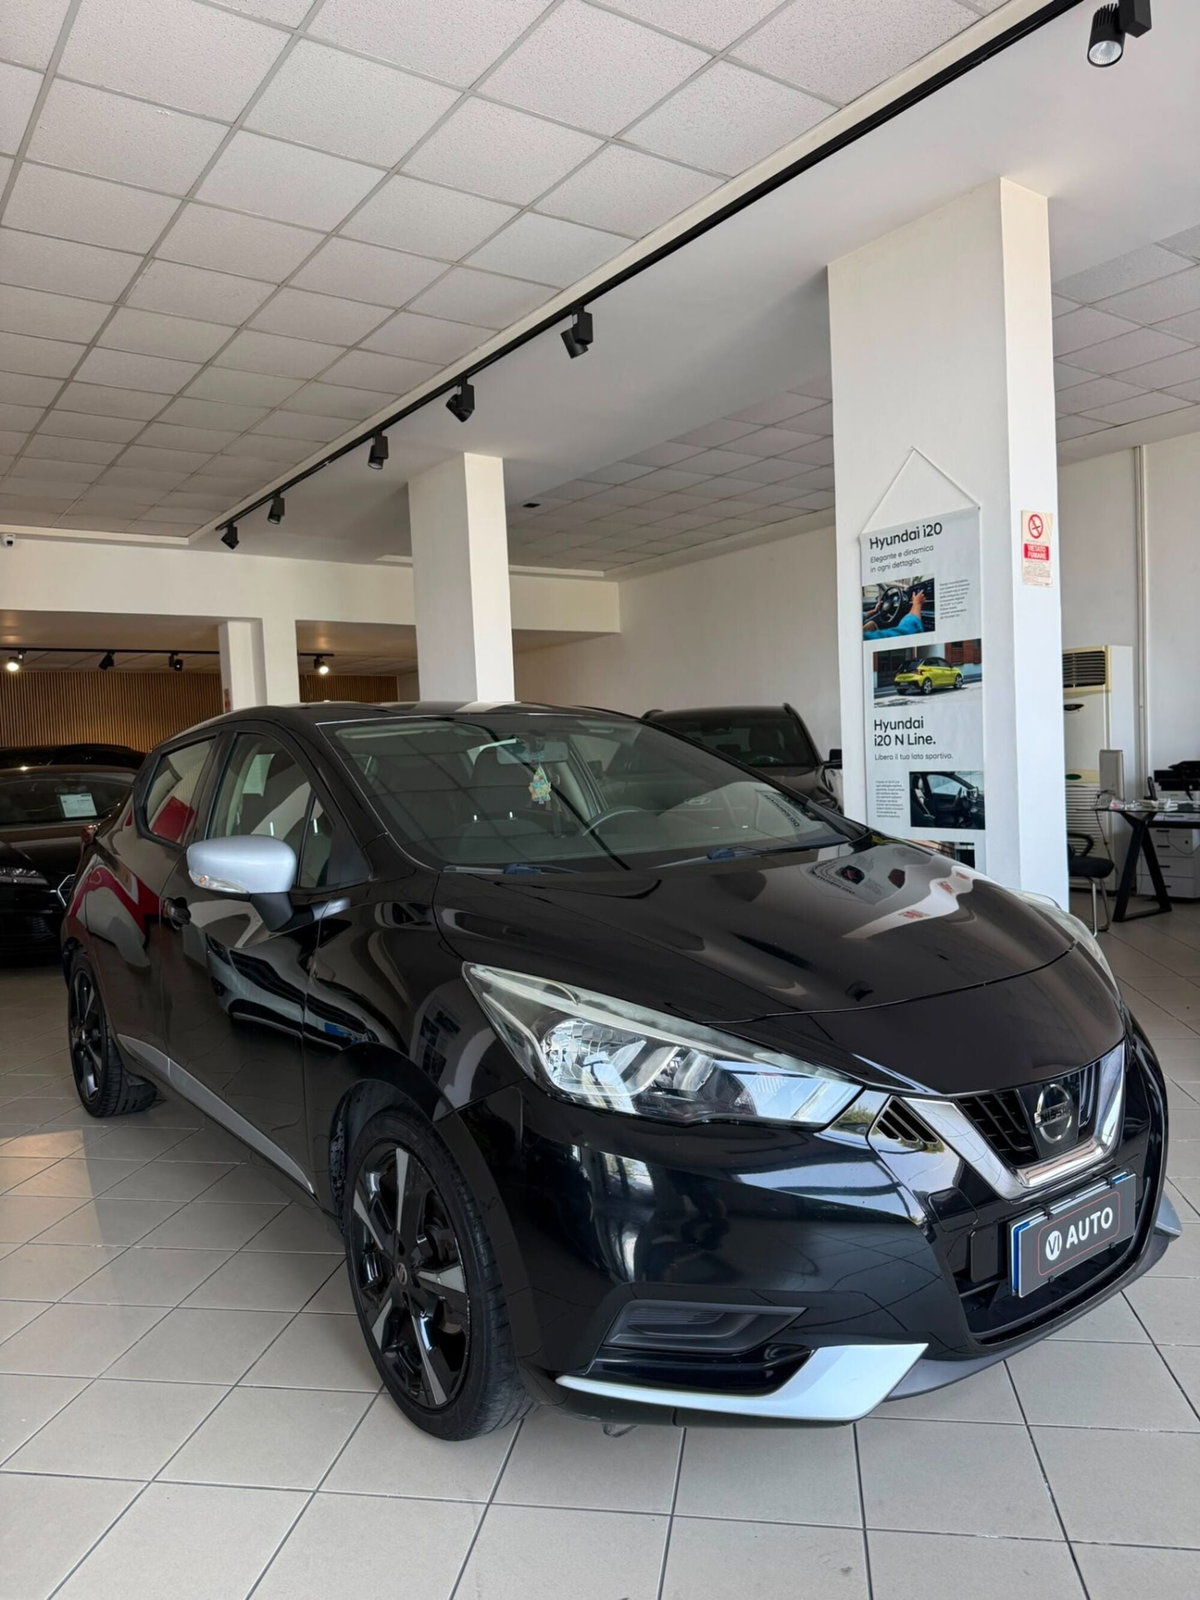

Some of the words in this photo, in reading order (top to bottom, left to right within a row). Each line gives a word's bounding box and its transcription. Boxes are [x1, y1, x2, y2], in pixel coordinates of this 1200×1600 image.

[869, 526, 920, 550] Hyundai
[922, 522, 943, 538] i20
[870, 553, 897, 564] Elegante
[903, 545, 934, 557] dinamica
[877, 563, 891, 572] ogni
[892, 558, 921, 569] dettaglio.
[874, 716, 924, 733] Hyundai
[874, 734, 892, 747] i20
[895, 733, 904, 746] N
[907, 732, 936, 745] Line.
[925, 753, 953, 761] sportivo.
[1066, 1207, 1113, 1249] AUTO
